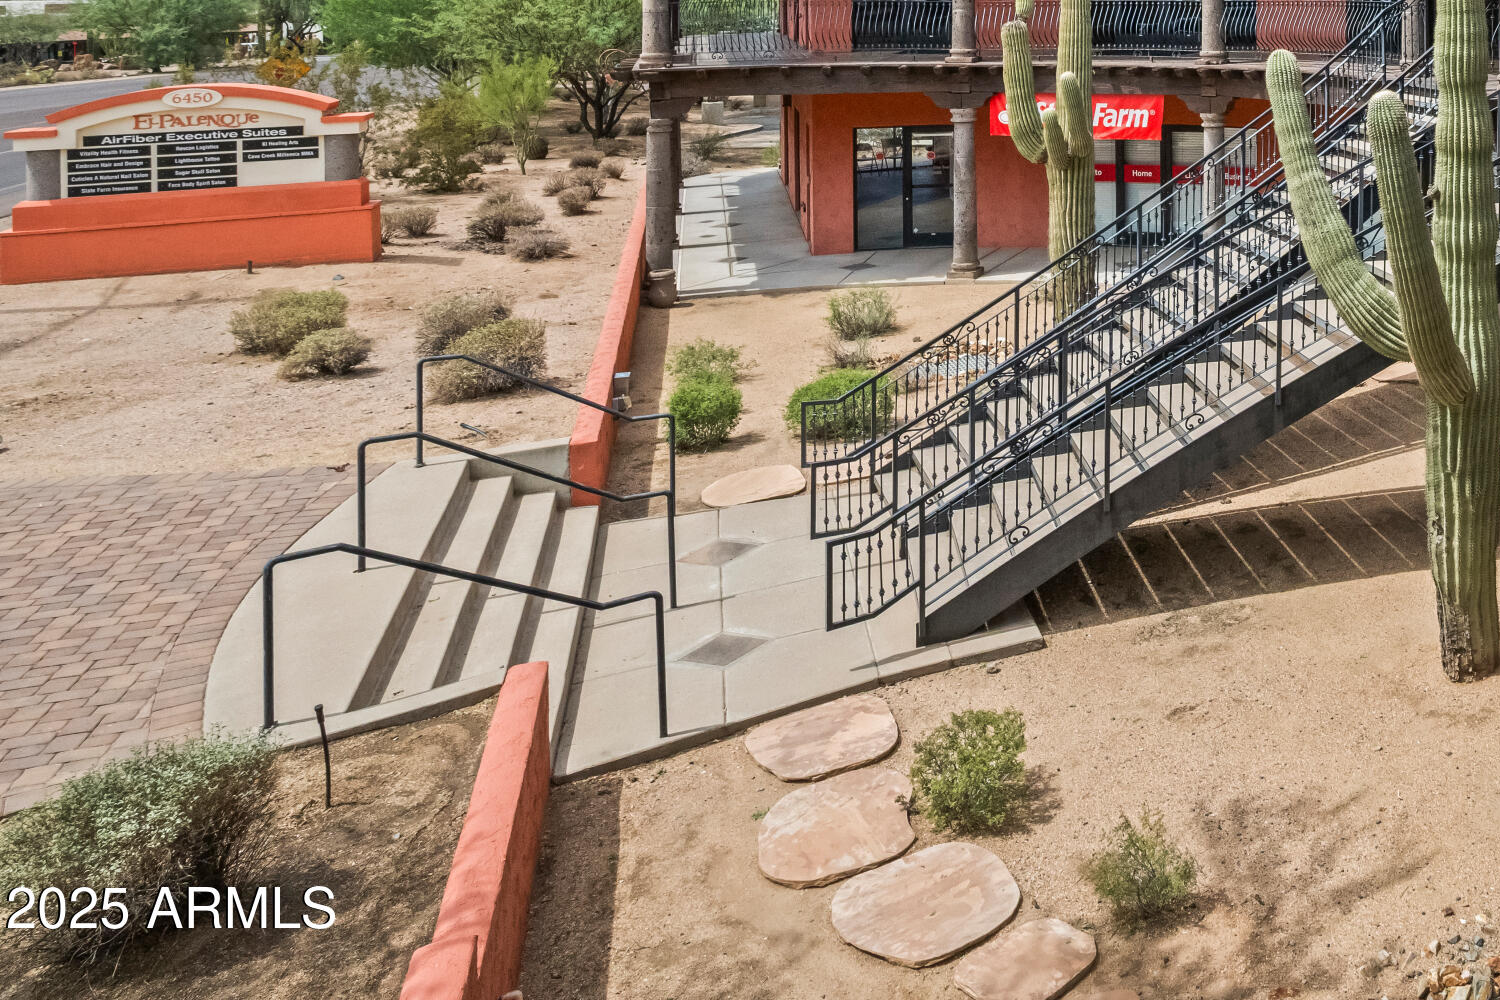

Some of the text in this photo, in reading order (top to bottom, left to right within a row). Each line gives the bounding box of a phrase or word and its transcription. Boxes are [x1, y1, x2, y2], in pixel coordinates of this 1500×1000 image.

[172, 92, 213, 104] 6450
[101, 128, 287, 145] AirFiber Executive Suites
[1132, 169, 1153, 177] Home
